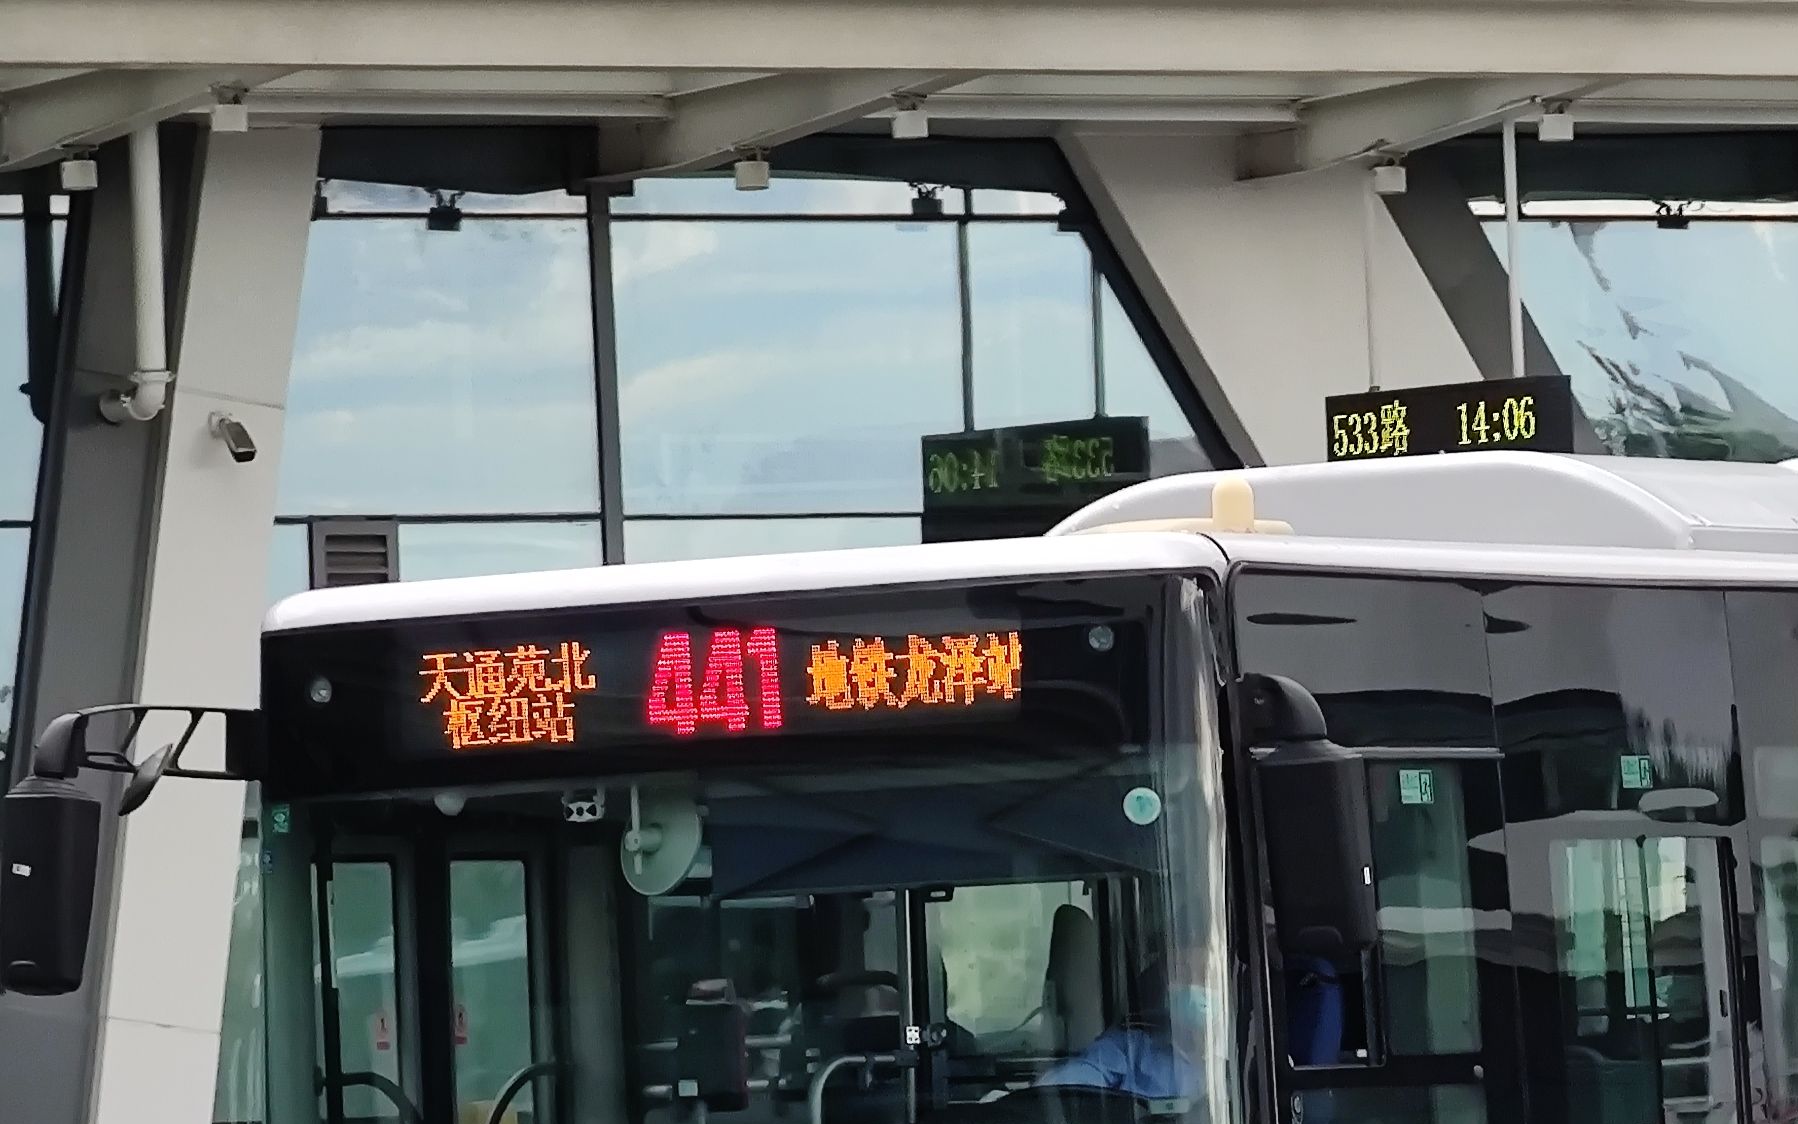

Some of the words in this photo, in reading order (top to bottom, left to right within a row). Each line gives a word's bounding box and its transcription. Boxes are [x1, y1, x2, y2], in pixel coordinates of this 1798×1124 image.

[1333, 400, 1410, 456] 533路
[1456, 396, 1536, 445] 14:06
[419, 641, 596, 703] 天通苑北
[648, 628, 782, 734] 441
[443, 692, 576, 749] 枢纽站
